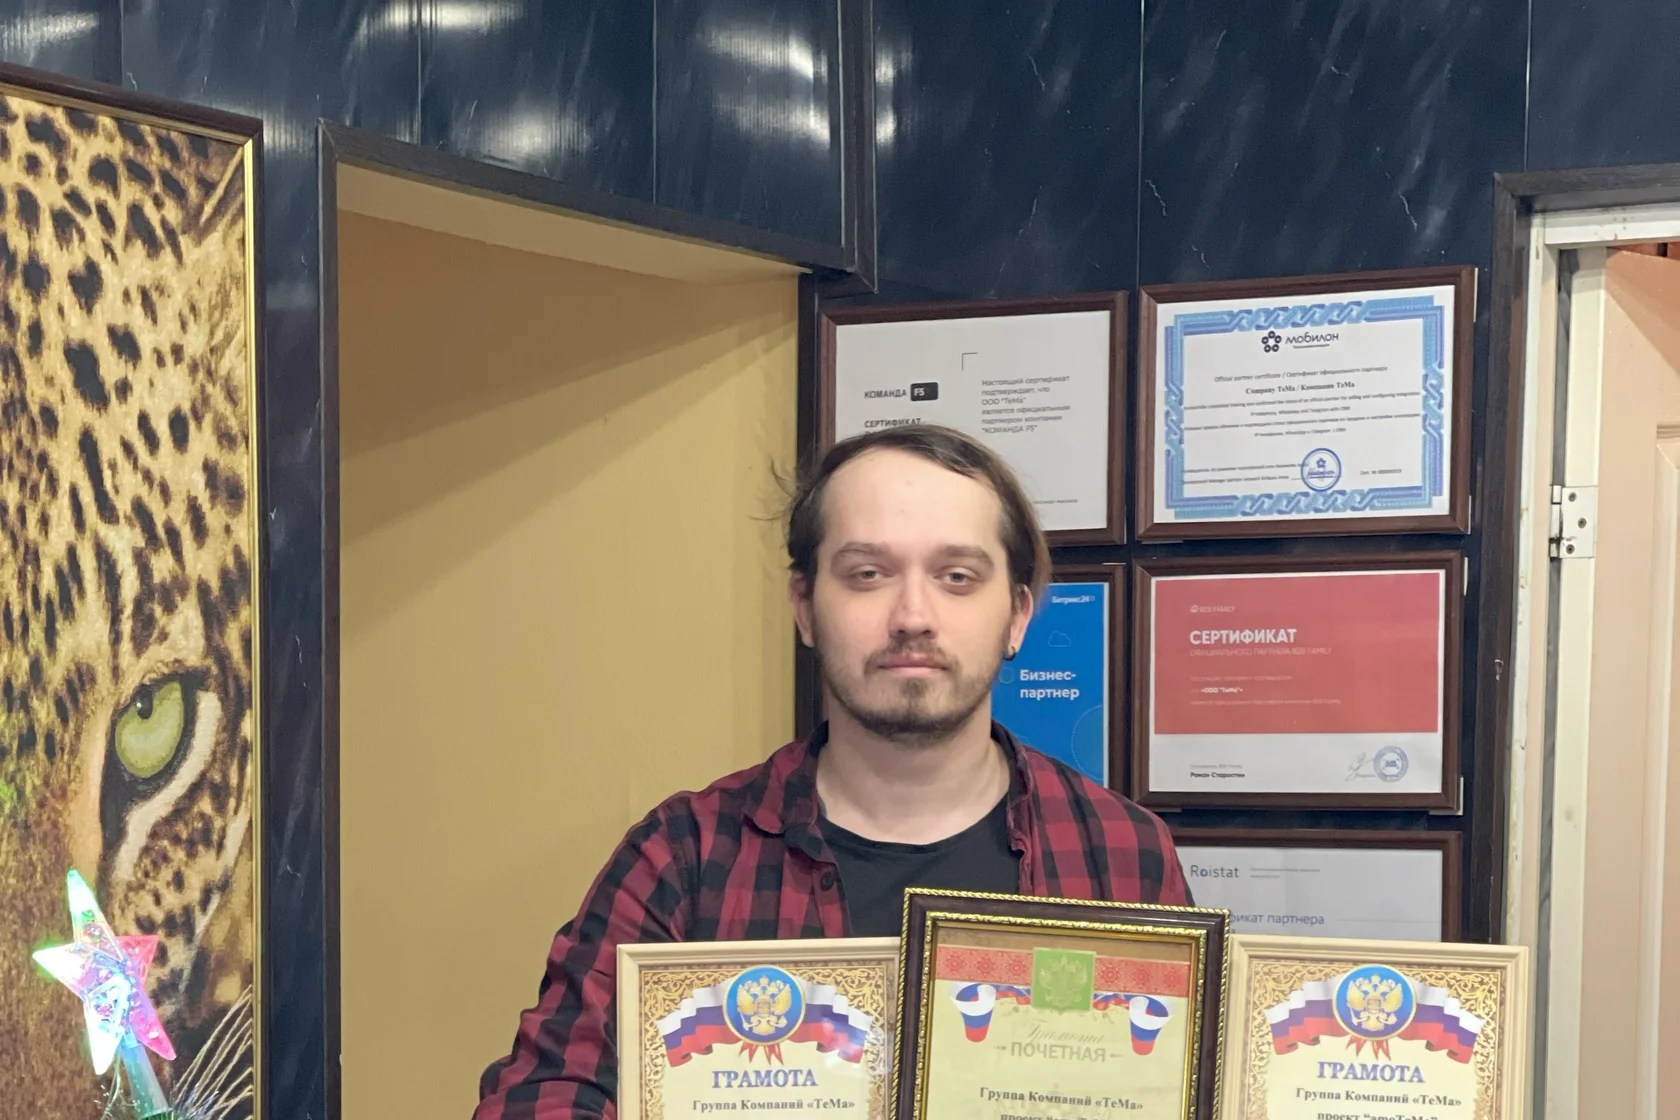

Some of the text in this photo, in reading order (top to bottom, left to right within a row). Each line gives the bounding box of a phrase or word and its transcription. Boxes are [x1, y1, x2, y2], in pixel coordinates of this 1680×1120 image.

[864, 387, 926, 399] КОМАНДА F5
[864, 417, 921, 428] СЕРТИФИКАТ
[1190, 628, 1297, 645] СЕРТИФИКАТ
[1020, 669, 1077, 681] Бизнес-
[1020, 688, 1080, 701] партнер
[1190, 864, 1239, 878] Roistat
[1267, 914, 1325, 926] партнера
[1011, 1042, 1106, 1063] ПОЧЕТНАЯ
[712, 1069, 818, 1088] ГРАМОТА
[1317, 1061, 1425, 1083] ГРАМОТА
[980, 1087, 1143, 1110] Группа Компаний «ТеМа»
[1296, 1088, 1462, 1107] Группа Компаний «ТеМа»
[693, 1098, 855, 1113] Группа Компаний «ТеМа»
